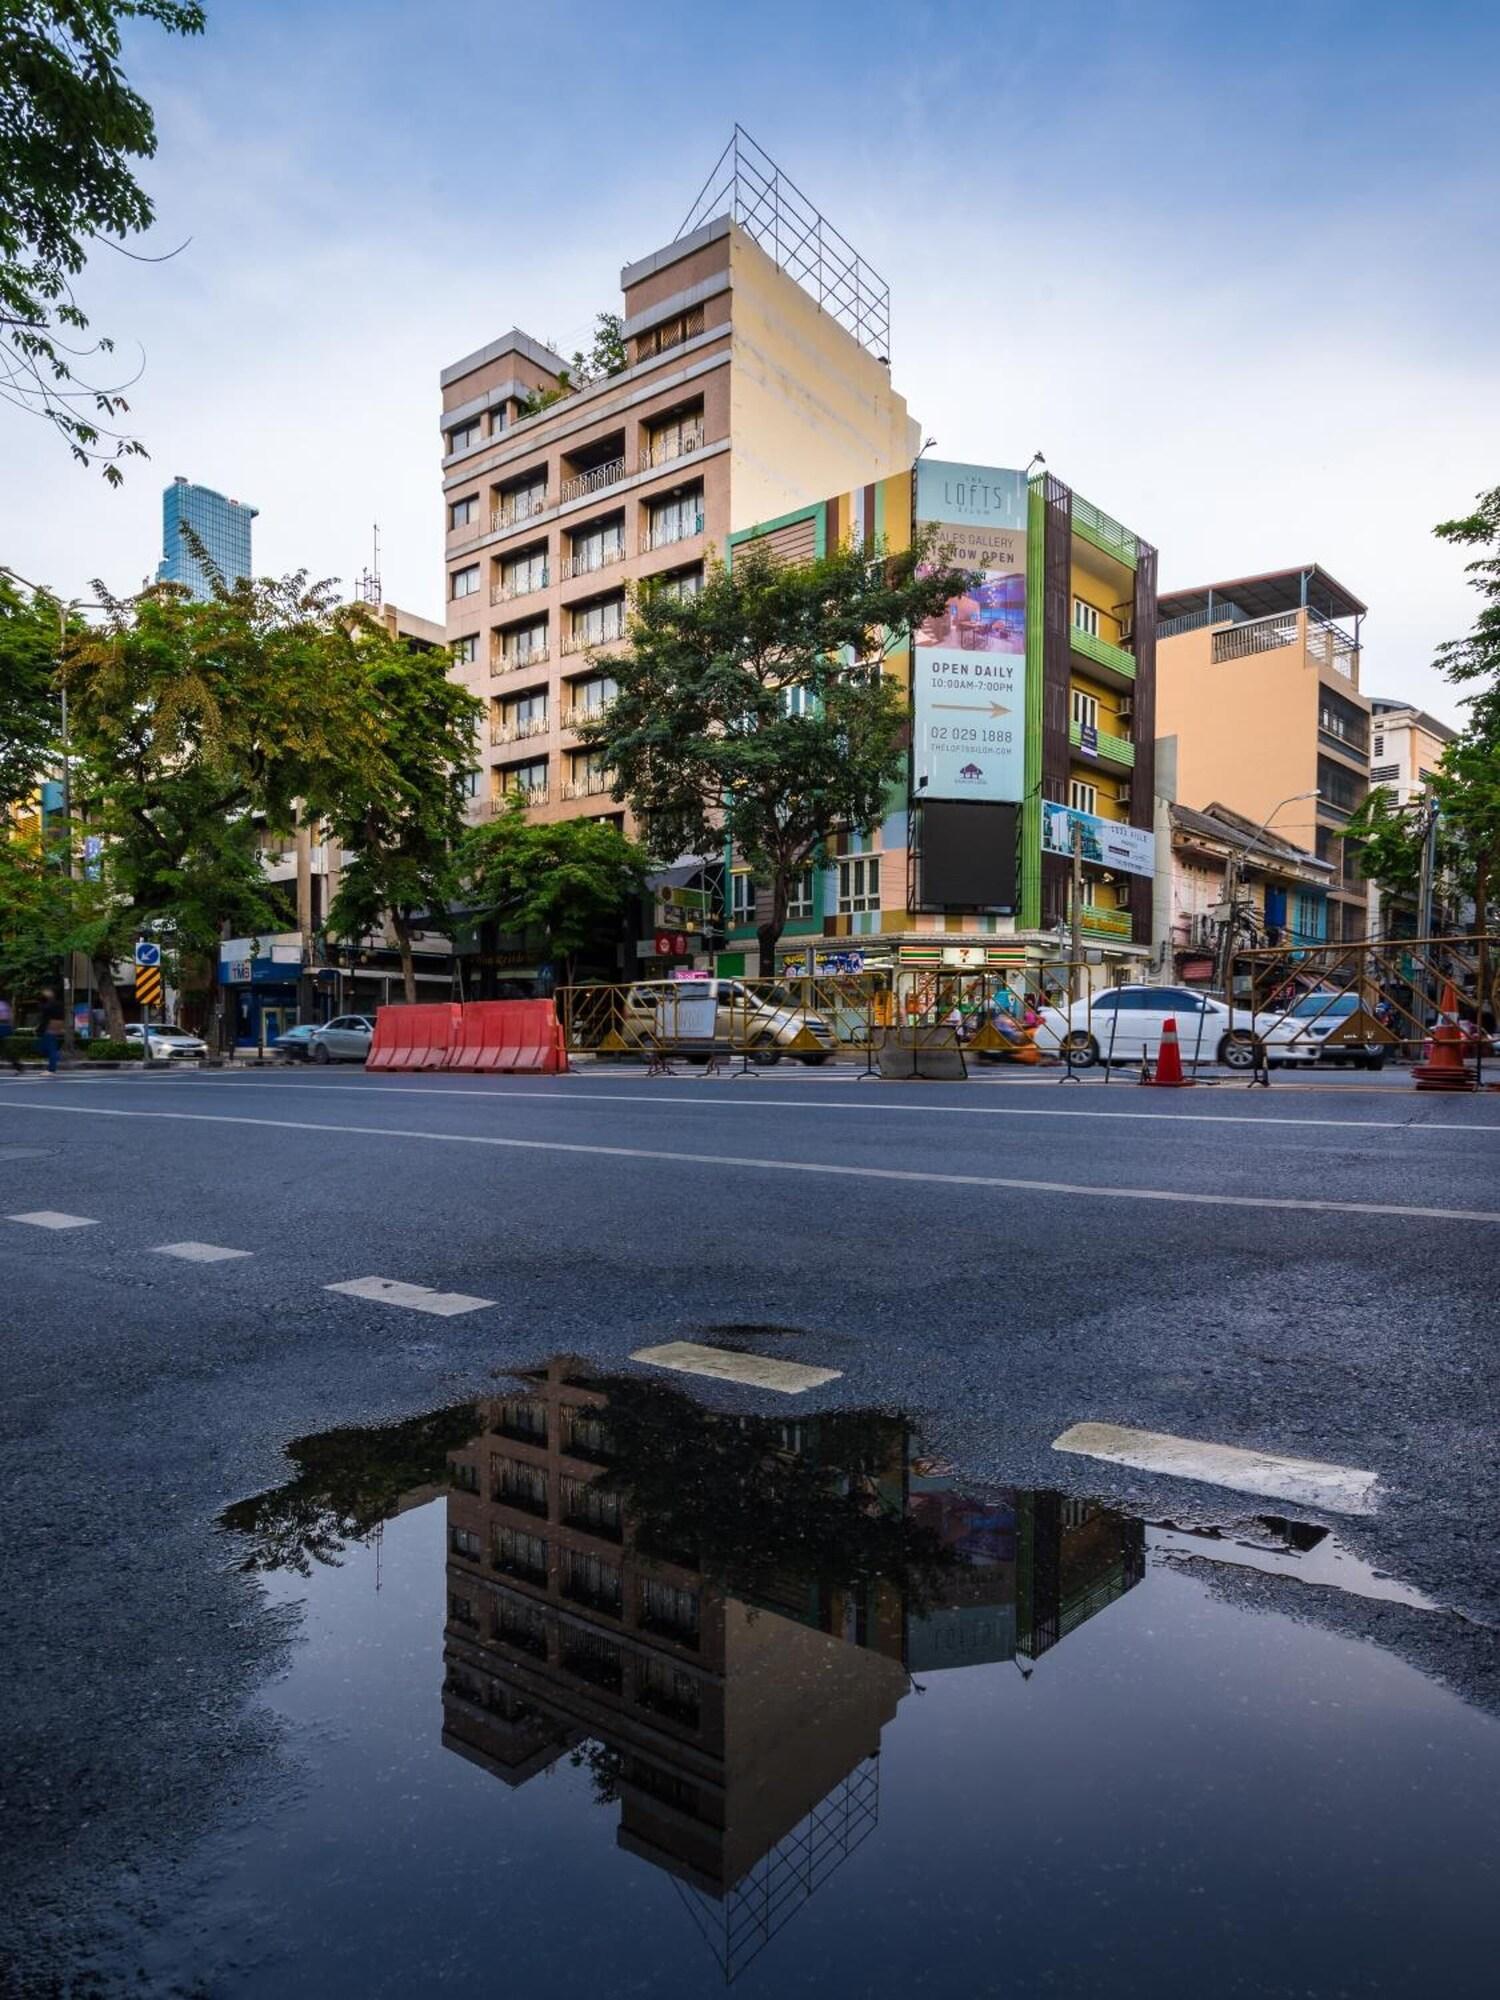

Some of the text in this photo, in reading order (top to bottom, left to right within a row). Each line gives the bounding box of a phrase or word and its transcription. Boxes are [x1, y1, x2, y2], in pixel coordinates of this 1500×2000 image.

[944, 481, 1001, 509] LOFTS
[968, 534, 1014, 548] GALLERY
[951, 547, 977, 560] NOW
[982, 551, 1014, 563] OPEN
[932, 662, 1013, 678] OPEN DAILY
[932, 678, 1013, 692] 10:00AM-7:00PM
[931, 727, 1012, 743] 02 029 1888
[232, 967, 250, 980] TMB
